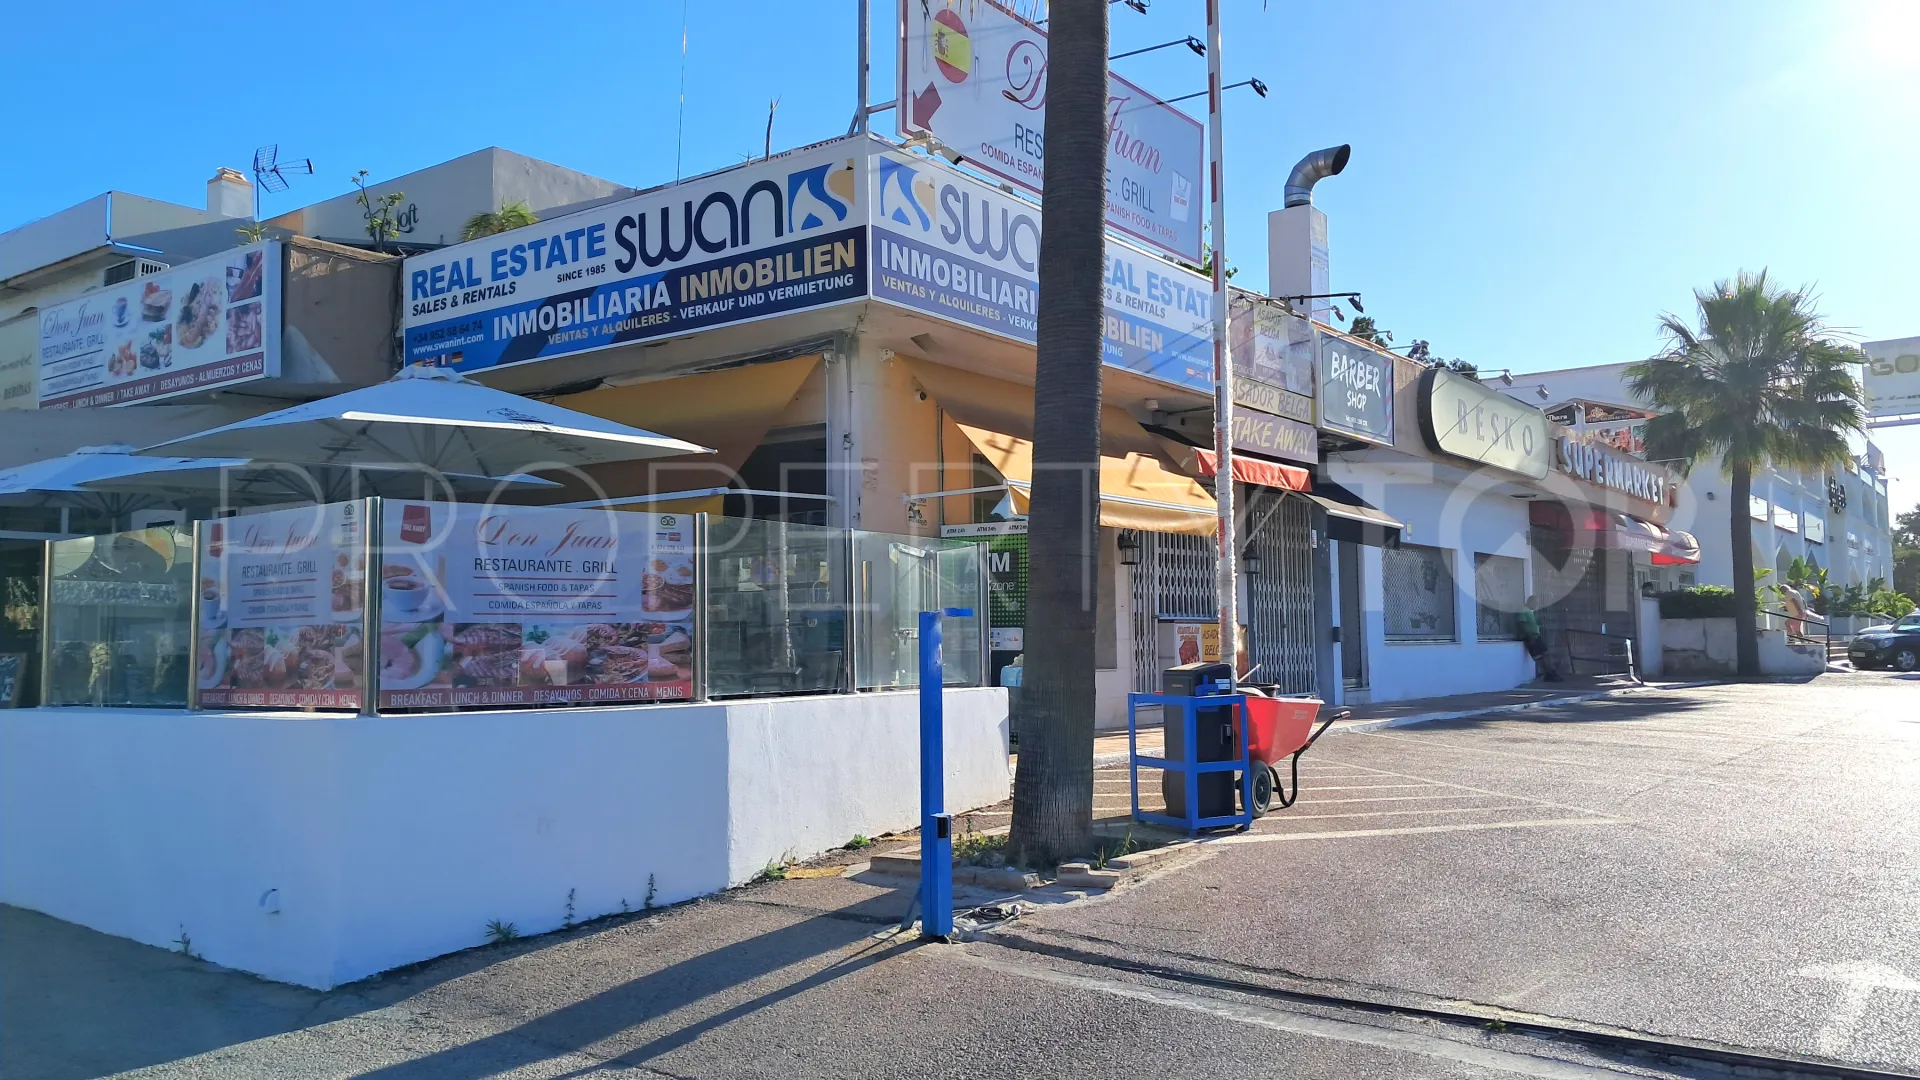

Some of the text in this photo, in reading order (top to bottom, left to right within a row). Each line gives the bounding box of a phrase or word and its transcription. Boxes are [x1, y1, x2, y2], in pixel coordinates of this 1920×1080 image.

[981, 142, 1015, 168] COMIDA
[1121, 177, 1155, 213] GRILL
[615, 180, 784, 273] swan
[1131, 213, 1151, 230] FOOD
[1157, 224, 1177, 242] TAPAS
[411, 223, 606, 300] REAL ESTATE
[557, 263, 606, 283] SINCE 1985
[881, 238, 1039, 317] INMOBILIARI
[412, 281, 517, 317] SALES & RENTALS
[494, 239, 856, 341] INMOBILIARIA INMOBILIEN
[881, 274, 926, 299] VENTAS
[929, 288, 936, 301] Y
[938, 292, 1001, 321] ALQUILERES
[71, 299, 104, 338] Juan
[548, 327, 588, 345] VENTAS
[591, 325, 599, 336] Y
[601, 312, 671, 336] ALQUILERES
[680, 297, 735, 320] VERKAUF
[738, 292, 765, 308] UND
[768, 273, 854, 302] VERMIETUNG
[1125, 295, 1166, 319] RENTALS
[86, 334, 104, 348] GRILL
[471, 320, 483, 333] 74
[412, 333, 484, 355] www.swanint.com
[160, 376, 195, 391] DESAYUNOS
[199, 365, 235, 382] ALMUERZOS
[235, 364, 241, 374] Y
[241, 358, 263, 373] CENAS
[1331, 351, 1381, 398] BARBER
[1277, 392, 1310, 421] BELGA
[1346, 390, 1367, 412] SHOP
[1233, 416, 1314, 457] TAKE AWAY
[1457, 398, 1533, 457] BESKO
[1561, 436, 1664, 505] SUPERMARKET
[475, 514, 618, 557] Don Juan
[241, 560, 318, 579] RESTAURANTE GRILL
[474, 557, 573, 574] RESTAURANTE
[582, 560, 618, 574] GRILL
[498, 582, 595, 593] SPANISH FOOD & TAPAS
[488, 600, 523, 610] COMIDA
[576, 601, 603, 610] TAPAS
[390, 692, 443, 706] BREAKFAST
[450, 691, 481, 705] LUNCH
[482, 691, 490, 704] &
[491, 690, 524, 704] DINNER
[533, 688, 582, 702] DESAYUNOS
[588, 687, 621, 700] COMIDA
[621, 688, 628, 699] Y
[628, 686, 649, 699] CENA
[655, 685, 683, 698] MENUS
